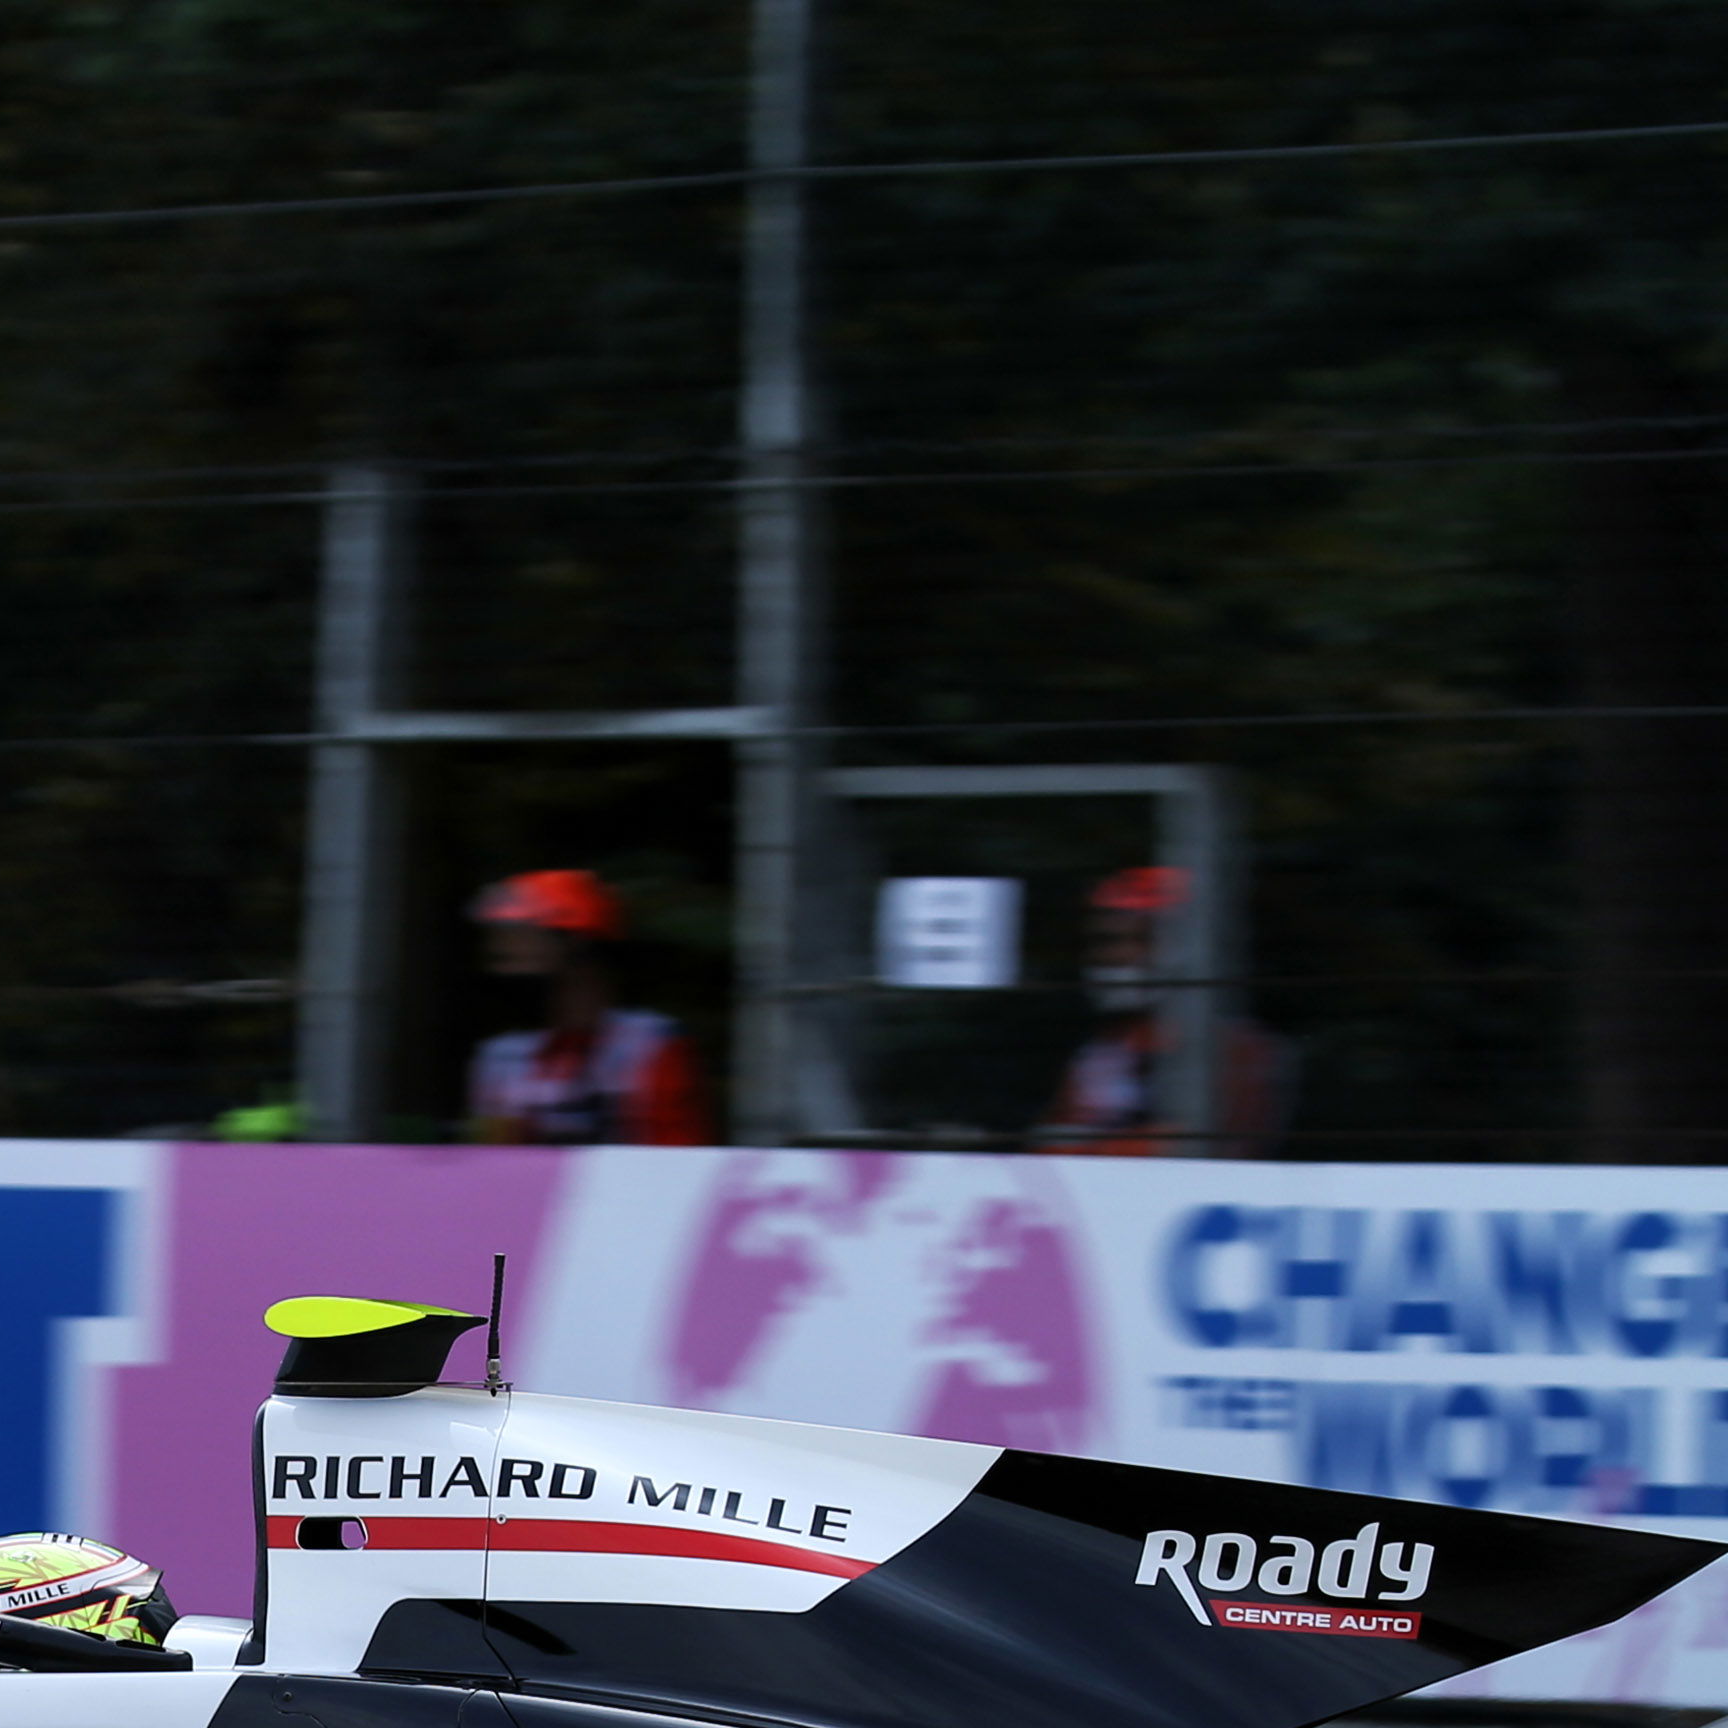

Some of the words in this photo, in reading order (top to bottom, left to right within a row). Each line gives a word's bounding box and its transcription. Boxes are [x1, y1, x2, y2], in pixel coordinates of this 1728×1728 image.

[1162, 1204, 1728, 1359] CHANG
[1294, 1380, 1728, 1516] WORL
[271, 1455, 599, 1500] RICHARD
[627, 1474, 853, 1544] MILLE
[7, 1582, 71, 1608] MILLE
[1134, 1521, 1435, 1627] Roady
[1225, 1606, 1332, 1629] CENTRE
[1338, 1614, 1413, 1633] AUTO
